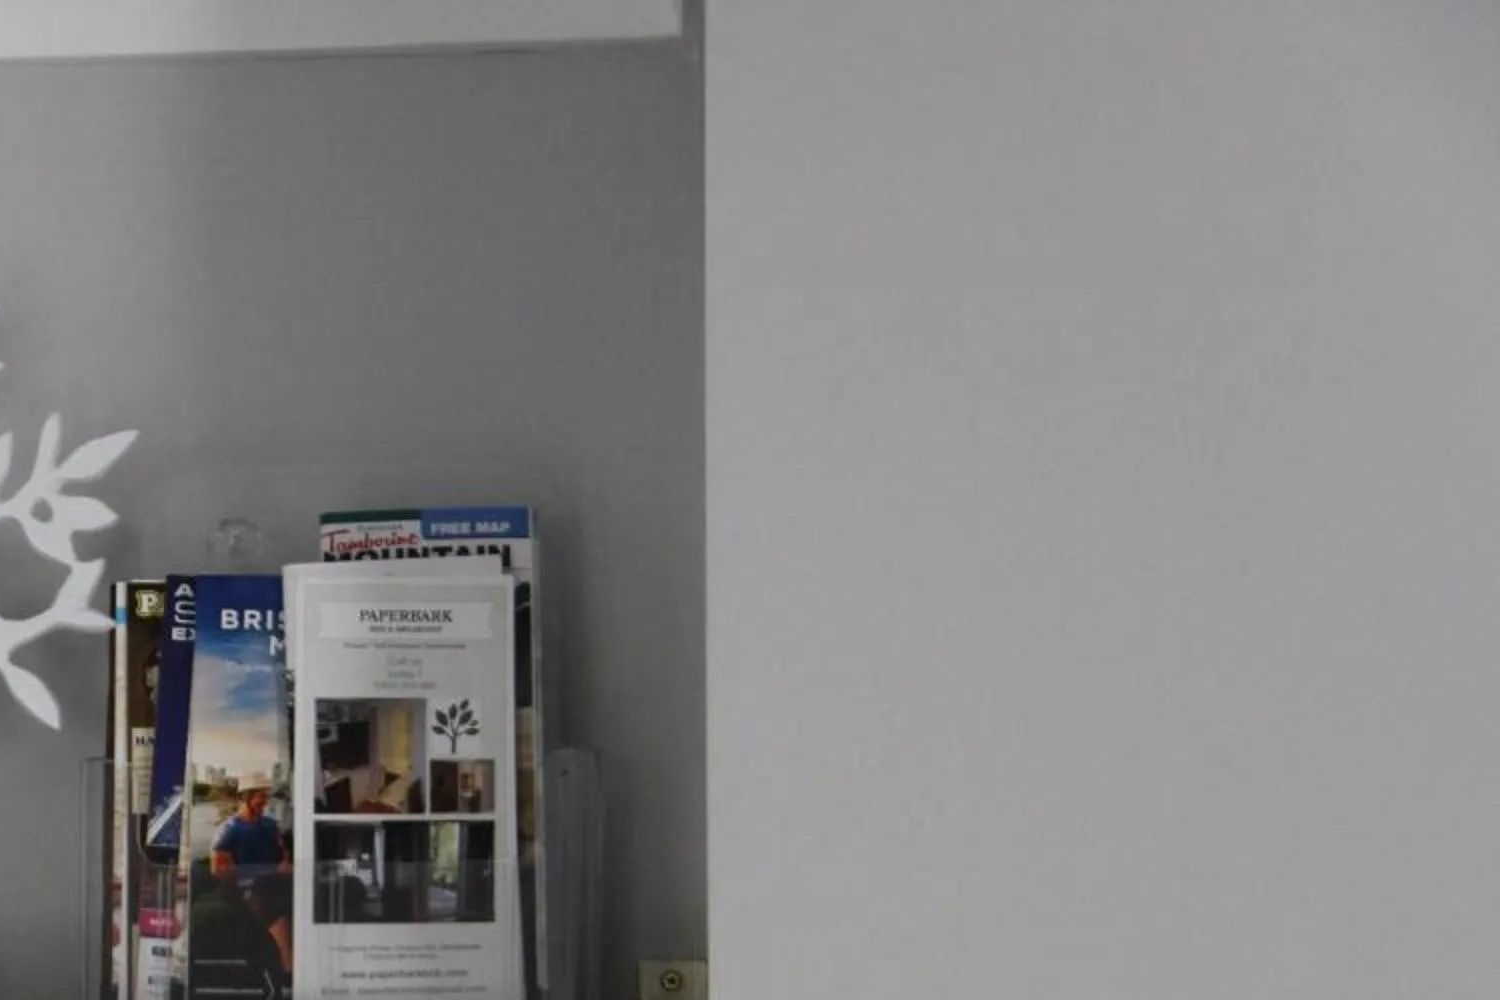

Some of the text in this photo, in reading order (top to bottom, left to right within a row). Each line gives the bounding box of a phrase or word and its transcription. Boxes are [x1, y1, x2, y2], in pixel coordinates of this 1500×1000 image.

[430, 520, 511, 536] FREE MAP
[358, 609, 453, 623] PAPERBARK
